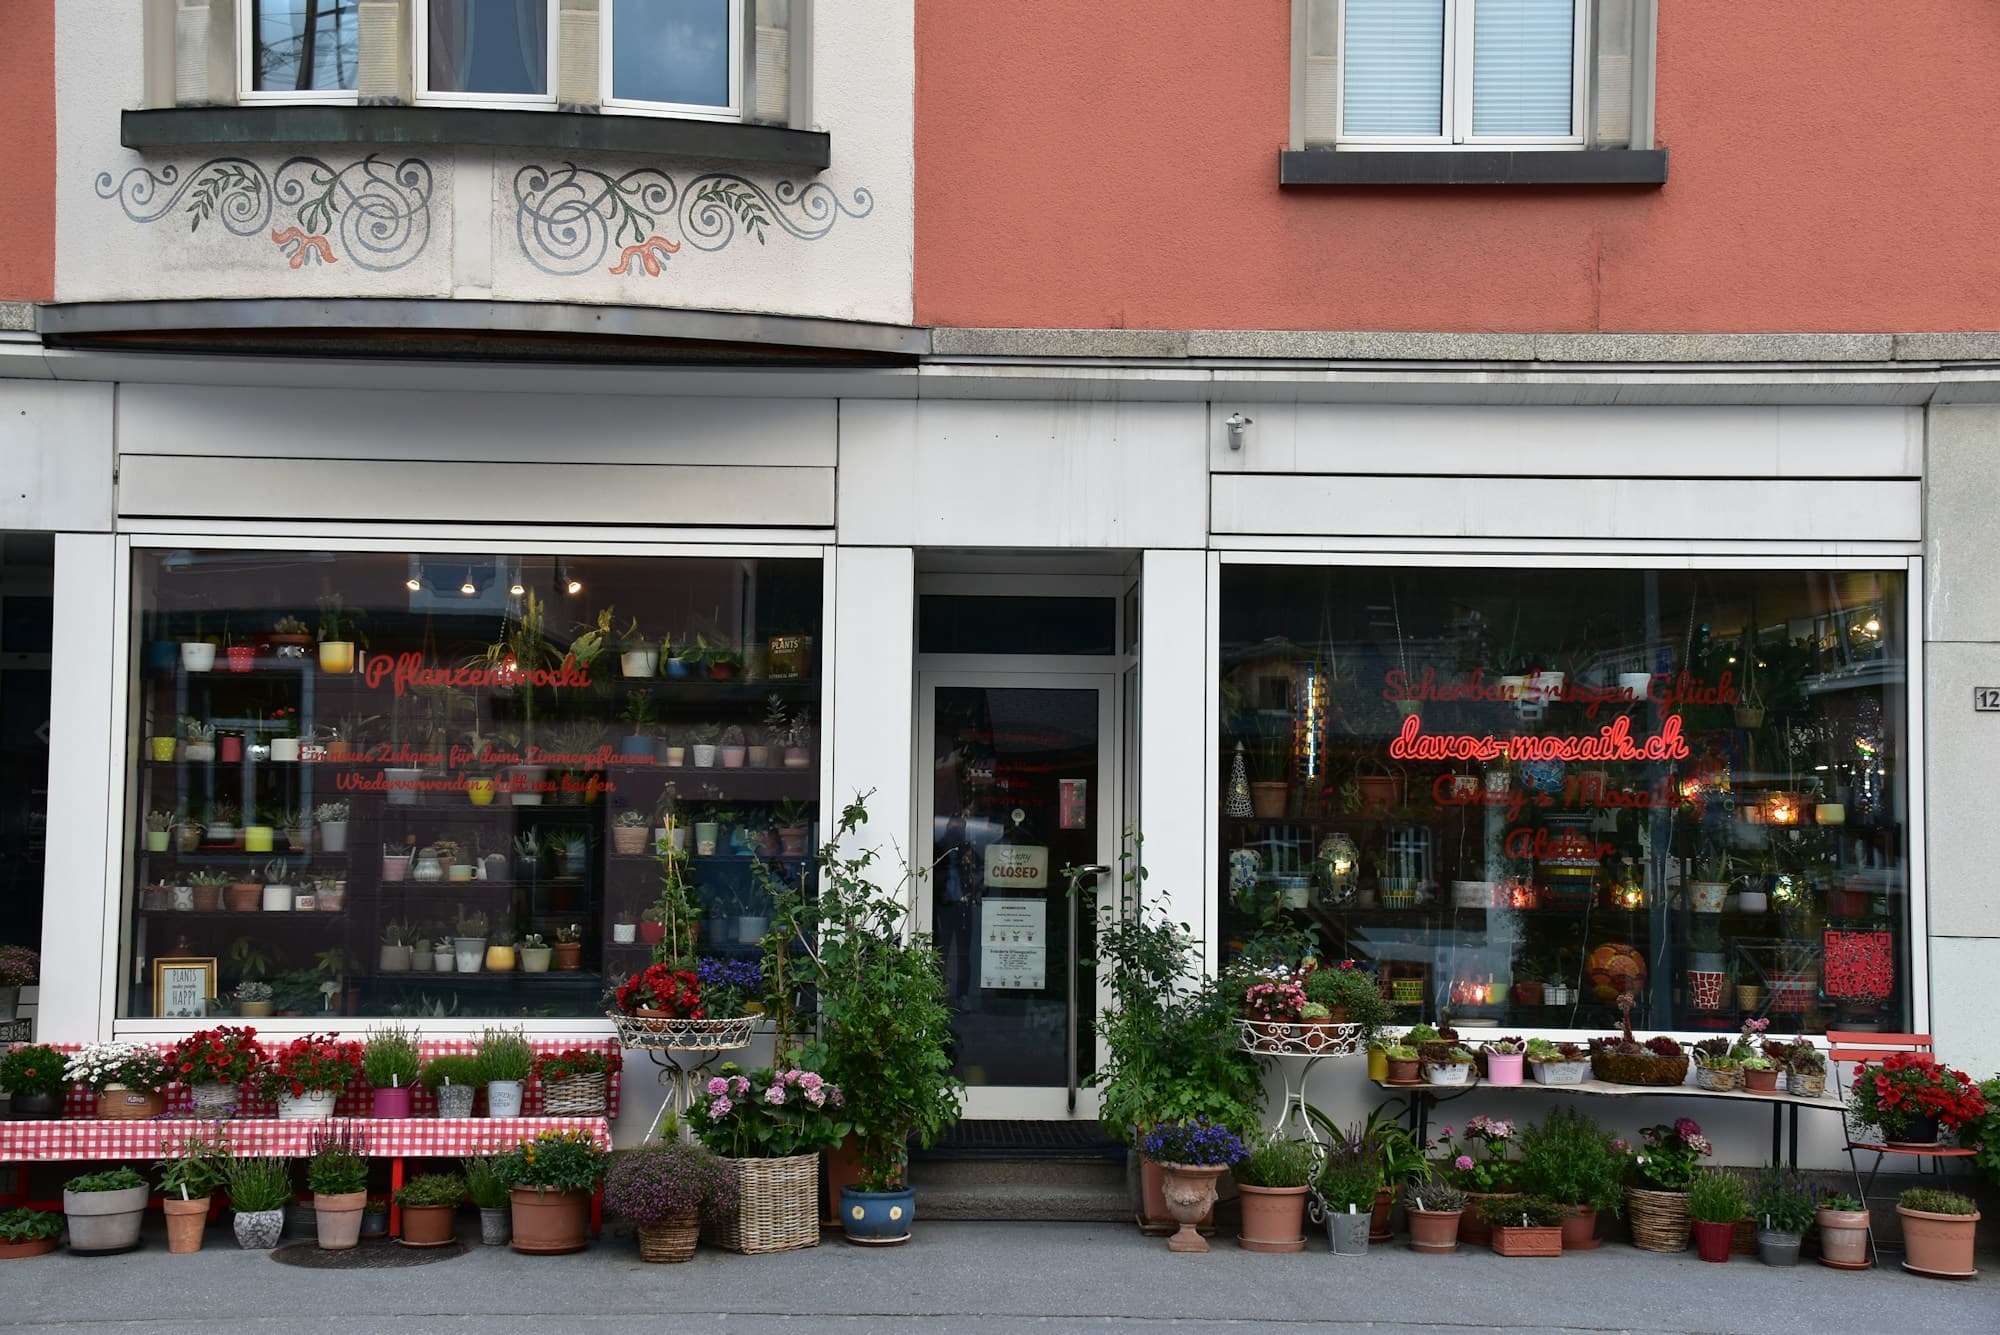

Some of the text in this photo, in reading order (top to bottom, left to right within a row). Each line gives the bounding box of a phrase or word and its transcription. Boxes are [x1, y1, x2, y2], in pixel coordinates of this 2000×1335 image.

[771, 639, 799, 650] PLANTS
[364, 652, 593, 696] Pflanzenbrocki
[1382, 666, 1741, 720] Scherben bringen Glück
[1979, 690, 2000, 707] 12
[1389, 714, 1690, 761] davos-mosaik.ch
[297, 743, 657, 771] Ein neues Zuhause für deine Zimmerpflanzen
[335, 772, 616, 797] Wiederverwenden statt neu kaufen
[1431, 772, 1682, 822] Conny's Mosaik
[1504, 825, 1618, 861] Atelier
[991, 865, 1039, 879] CLOSED
[172, 969, 197, 982] PLANTS
[172, 990, 197, 1006] HAPPY
